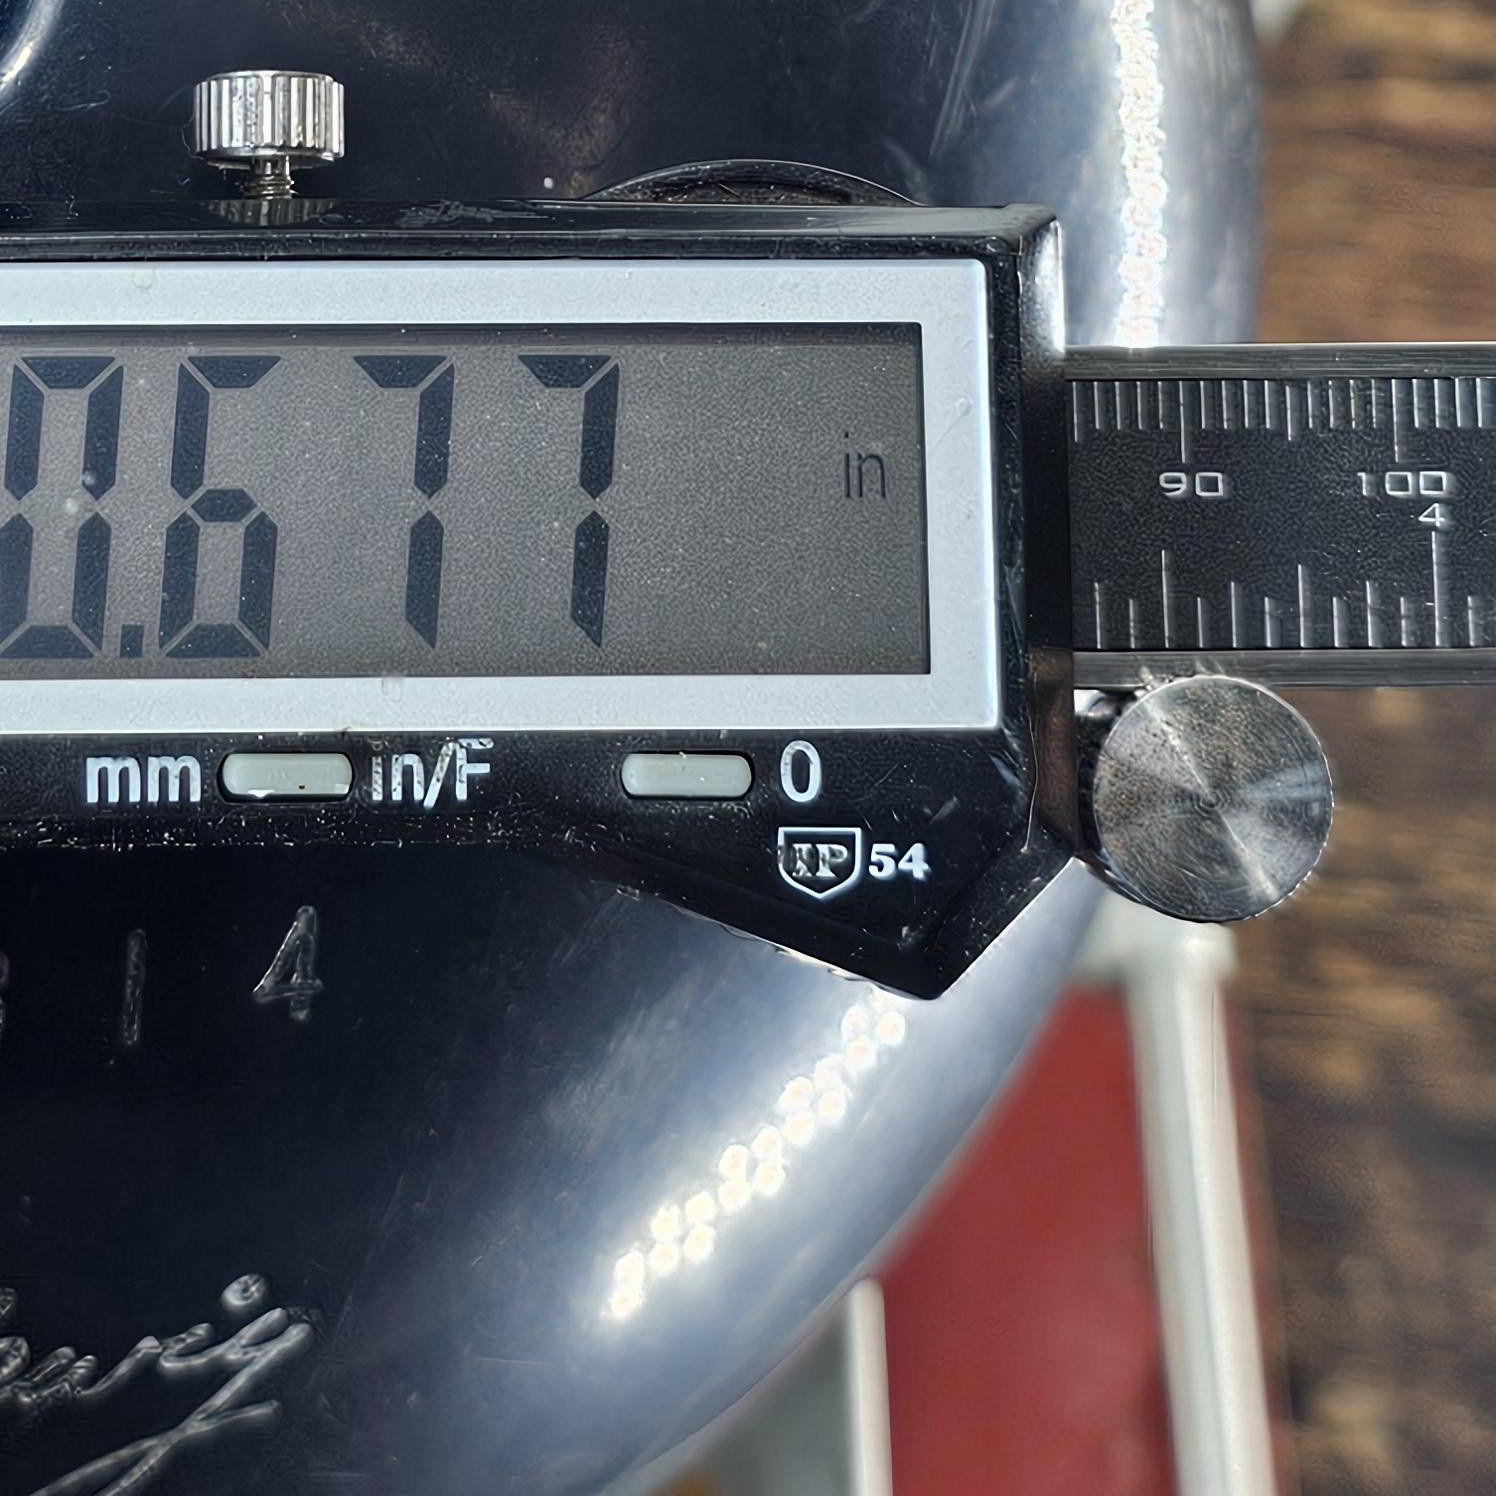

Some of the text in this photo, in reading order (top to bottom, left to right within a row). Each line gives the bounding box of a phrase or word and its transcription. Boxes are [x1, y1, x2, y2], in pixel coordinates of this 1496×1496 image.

[842, 431, 889, 498] in
[1357, 470, 1447, 496] 100
[1158, 471, 1225, 498] 90
[1417, 502, 1446, 528] 4
[85, 755, 202, 804] mm
[371, 738, 493, 806] in/F
